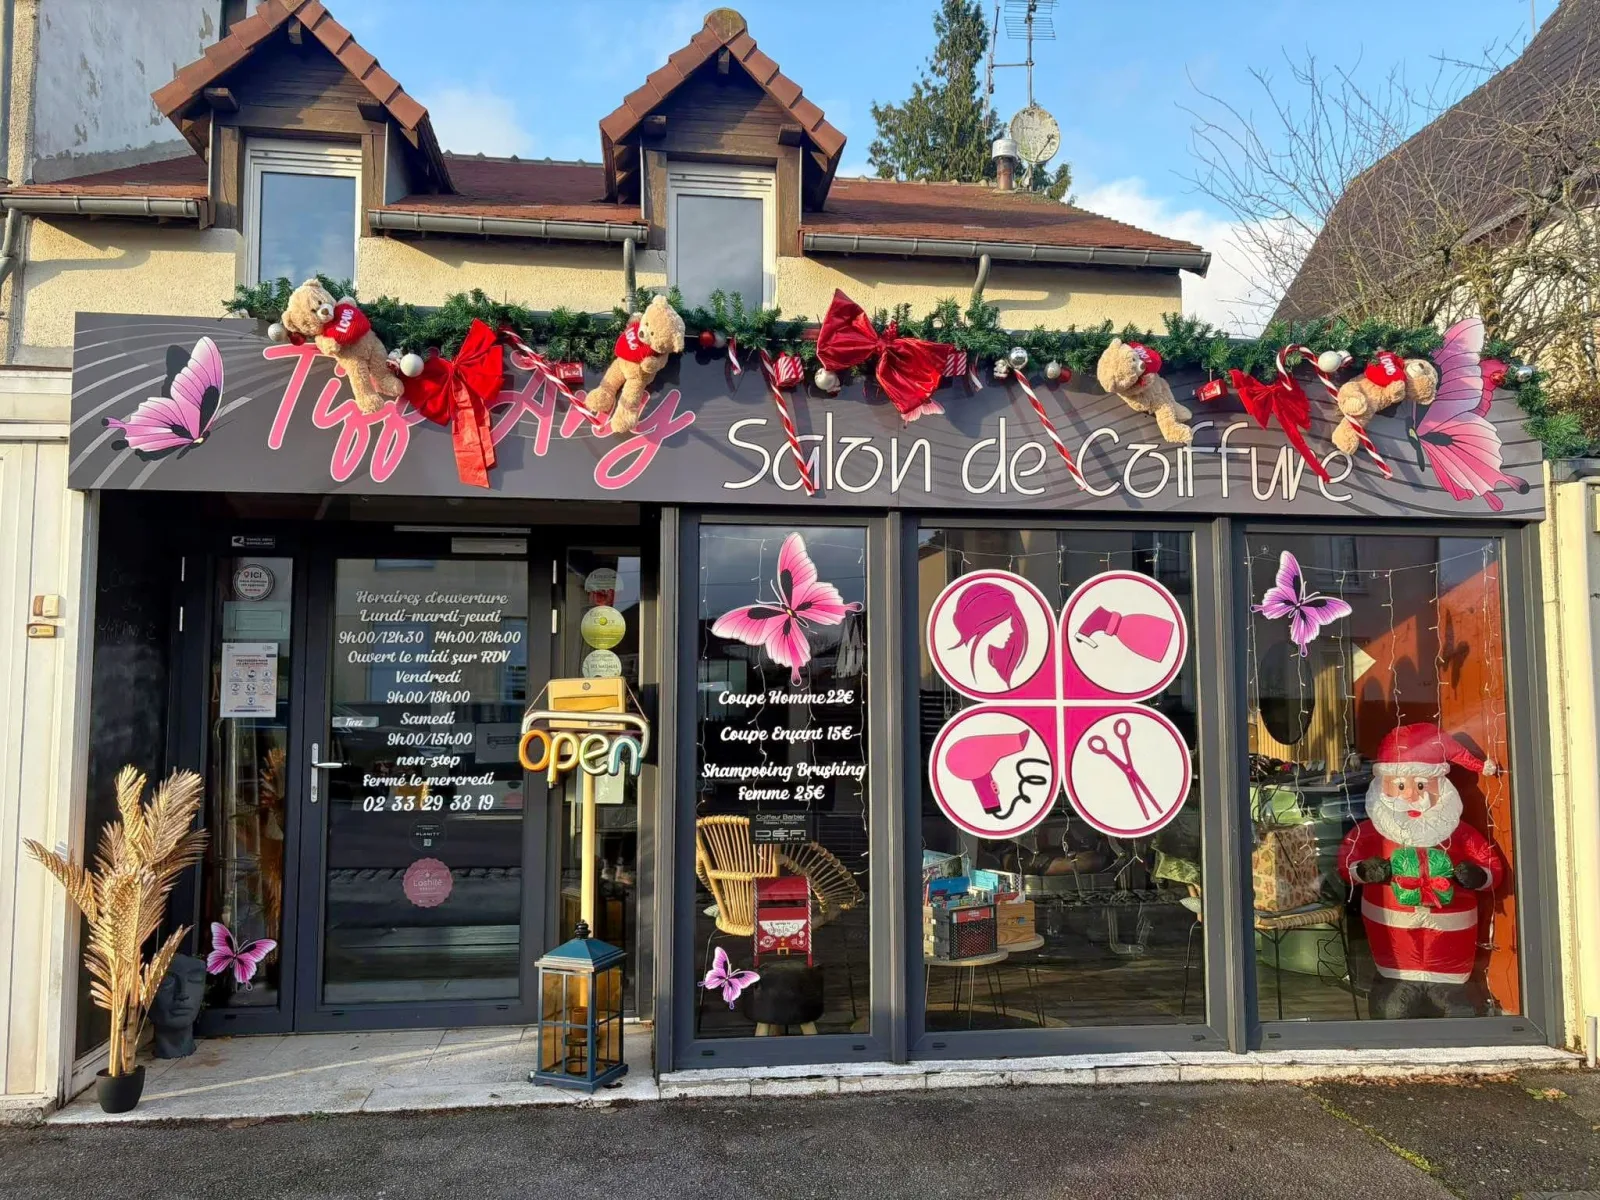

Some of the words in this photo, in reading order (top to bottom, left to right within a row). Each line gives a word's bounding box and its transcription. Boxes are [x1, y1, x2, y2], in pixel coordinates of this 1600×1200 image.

[721, 411, 932, 494] Salon
[961, 416, 1047, 495] de
[1076, 420, 1354, 502] Coiffure
[250, 571, 262, 579] ICI
[356, 590, 421, 605] Horaires
[424, 590, 508, 604] d'ouverture
[359, 608, 502, 627] Lundi-mardi-jeudi
[338, 631, 424, 644] 9h00/12h30
[434, 631, 521, 644] 14h00/18h00
[348, 650, 396, 663] Ouvert
[399, 650, 413, 663] le
[415, 649, 449, 663] midi
[451, 652, 477, 664] sur
[480, 650, 511, 663] RDV
[395, 669, 462, 683] Vendredi
[386, 690, 471, 704] 9h00/18h00
[718, 690, 767, 708] Coupe
[400, 711, 455, 725] Samedi
[387, 732, 472, 746] 9h00/15h00
[720, 726, 768, 742] Coupe
[771, 726, 824, 744] Enfant
[827, 725, 853, 740] 15€
[396, 754, 460, 769] non-stop
[519, 729, 641, 786] open
[701, 761, 793, 782] Shampooing
[796, 760, 867, 781] Brushing
[363, 773, 406, 787] Fermé
[409, 773, 423, 786] le
[426, 772, 494, 786] mercredi
[738, 785, 790, 800] Femme
[794, 785, 825, 801] 25€
[363, 796, 386, 812] 02
[391, 795, 415, 811] 33
[421, 795, 444, 811] 29
[449, 795, 472, 811] 38
[477, 794, 494, 810] 19
